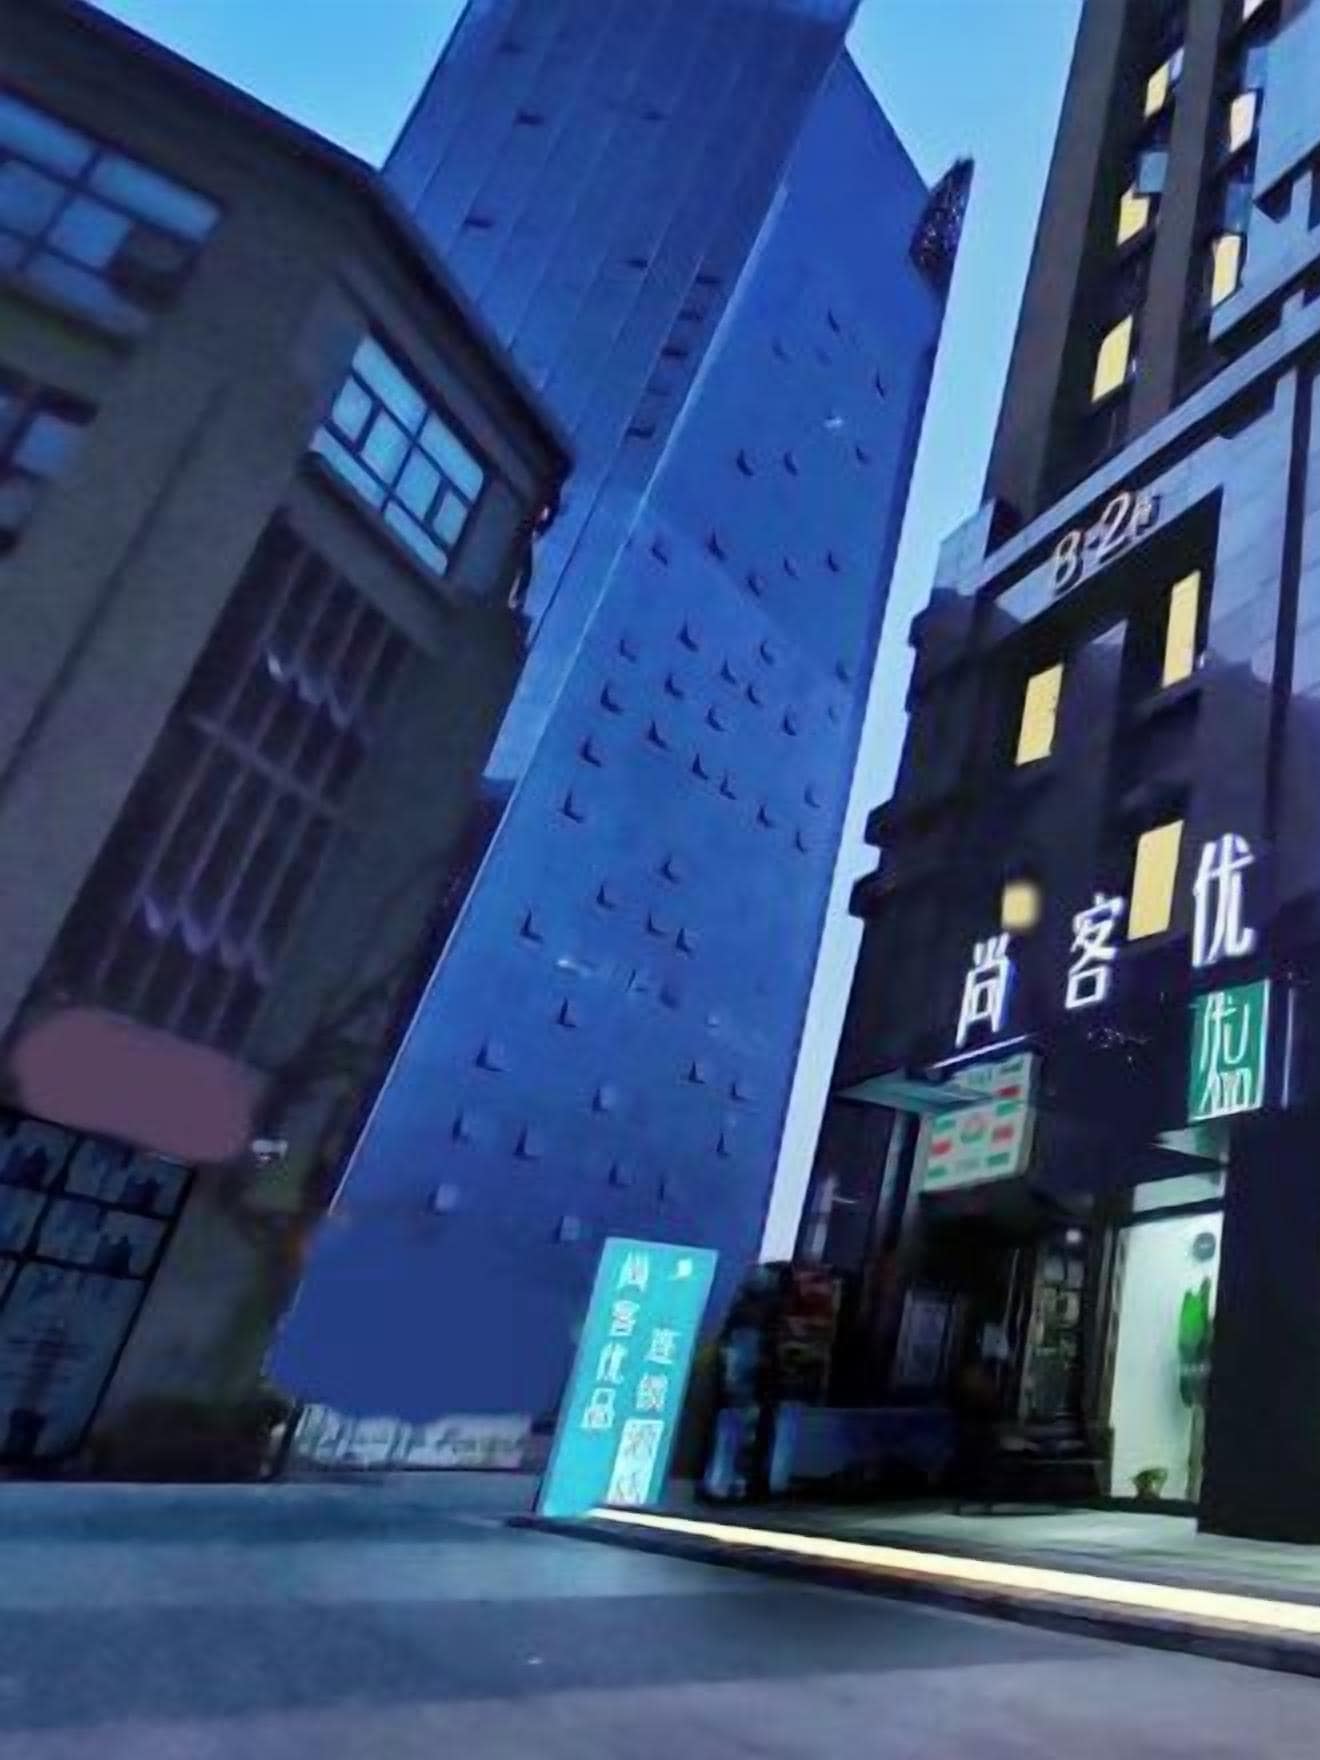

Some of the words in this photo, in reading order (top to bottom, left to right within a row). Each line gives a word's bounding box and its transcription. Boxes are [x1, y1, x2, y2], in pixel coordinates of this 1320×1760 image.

[1198, 991, 1253, 1114] 优品
[580, 1250, 650, 1429] 尚客优品
